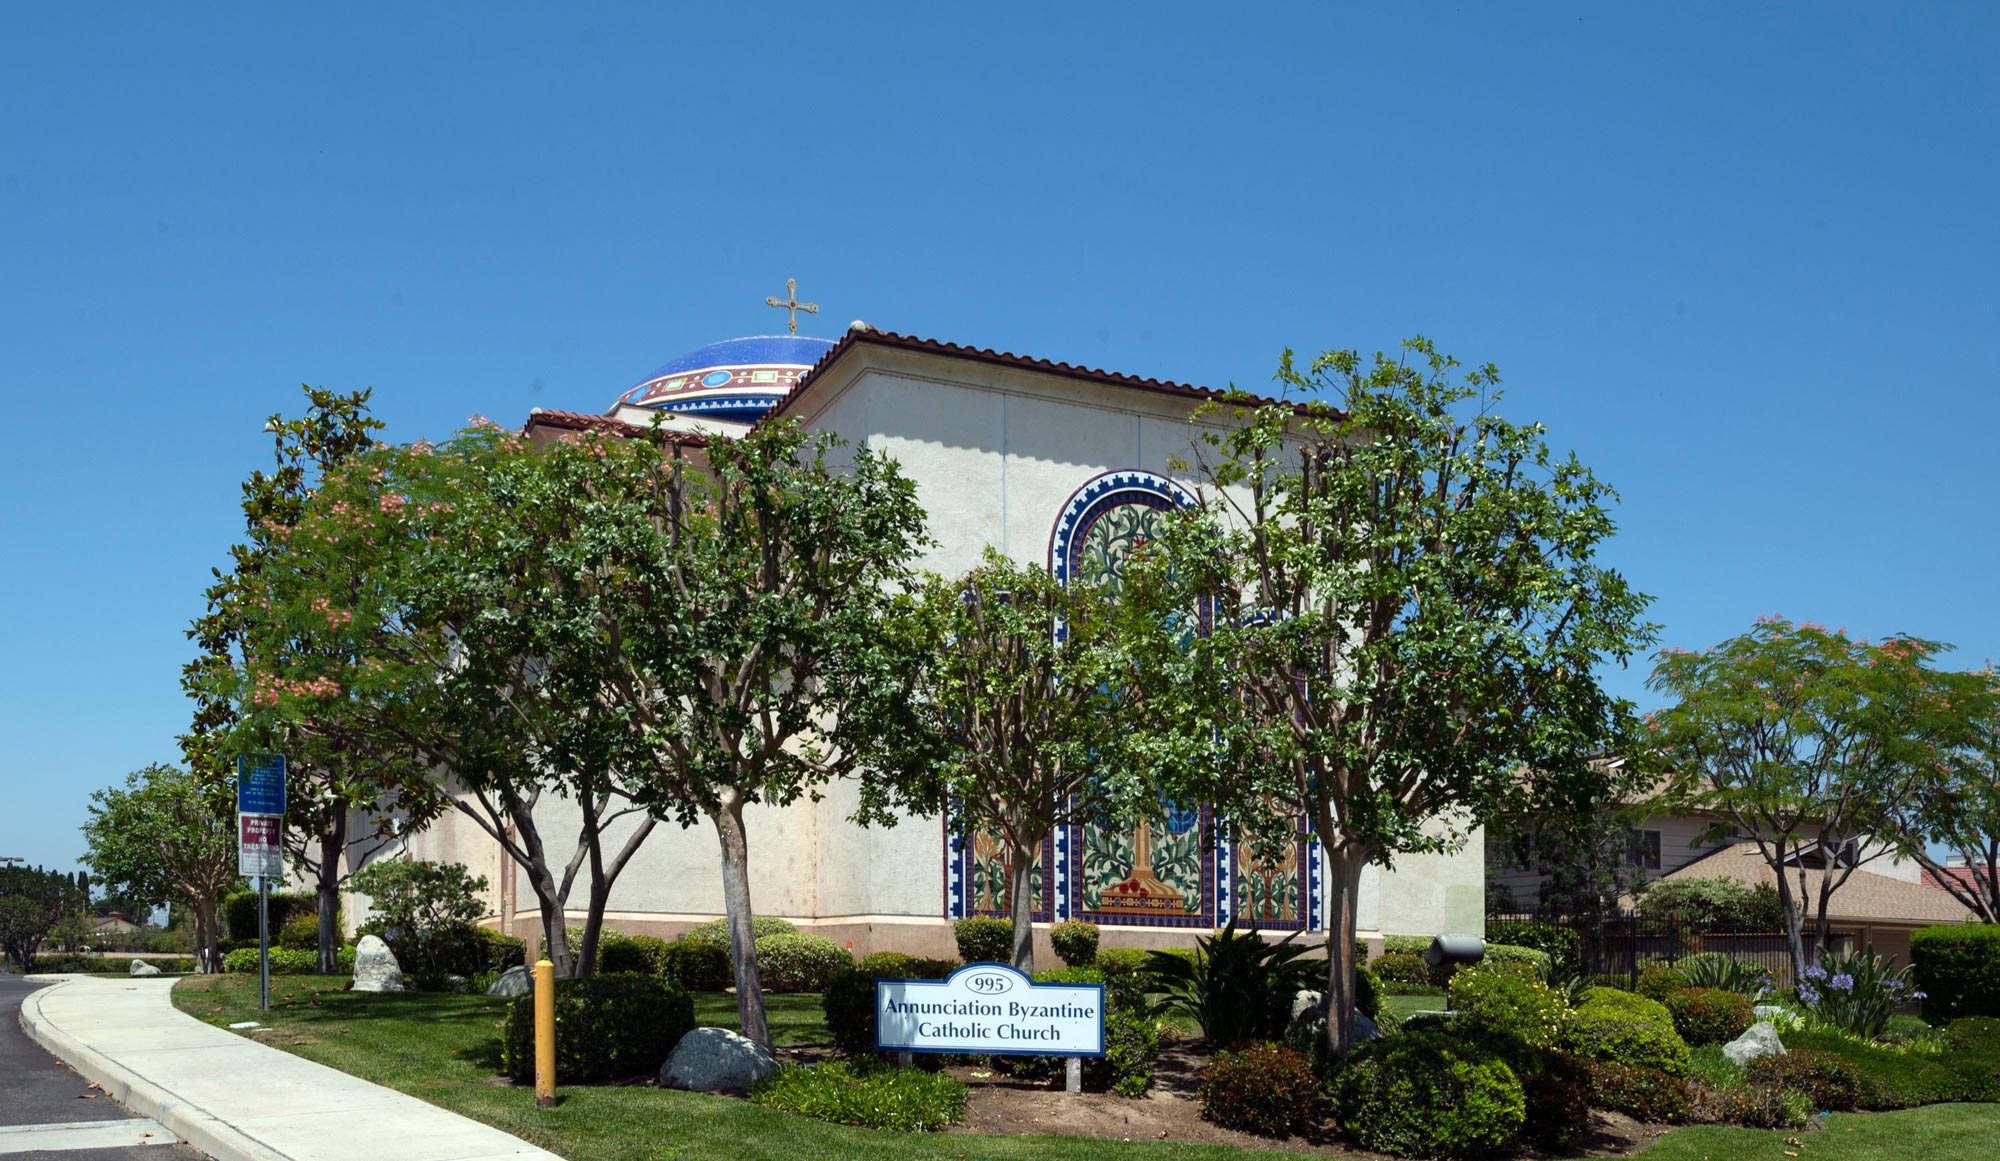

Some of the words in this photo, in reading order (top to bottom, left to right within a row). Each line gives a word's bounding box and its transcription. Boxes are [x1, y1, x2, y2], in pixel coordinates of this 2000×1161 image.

[247, 827, 276, 835] PROPERTY
[974, 977, 1004, 992] 995
[885, 998, 1002, 1016] Annunciation
[1008, 1001, 1094, 1022] Byzantine
[918, 1022, 991, 1039] Catholic
[996, 1023, 1061, 1040] Church
